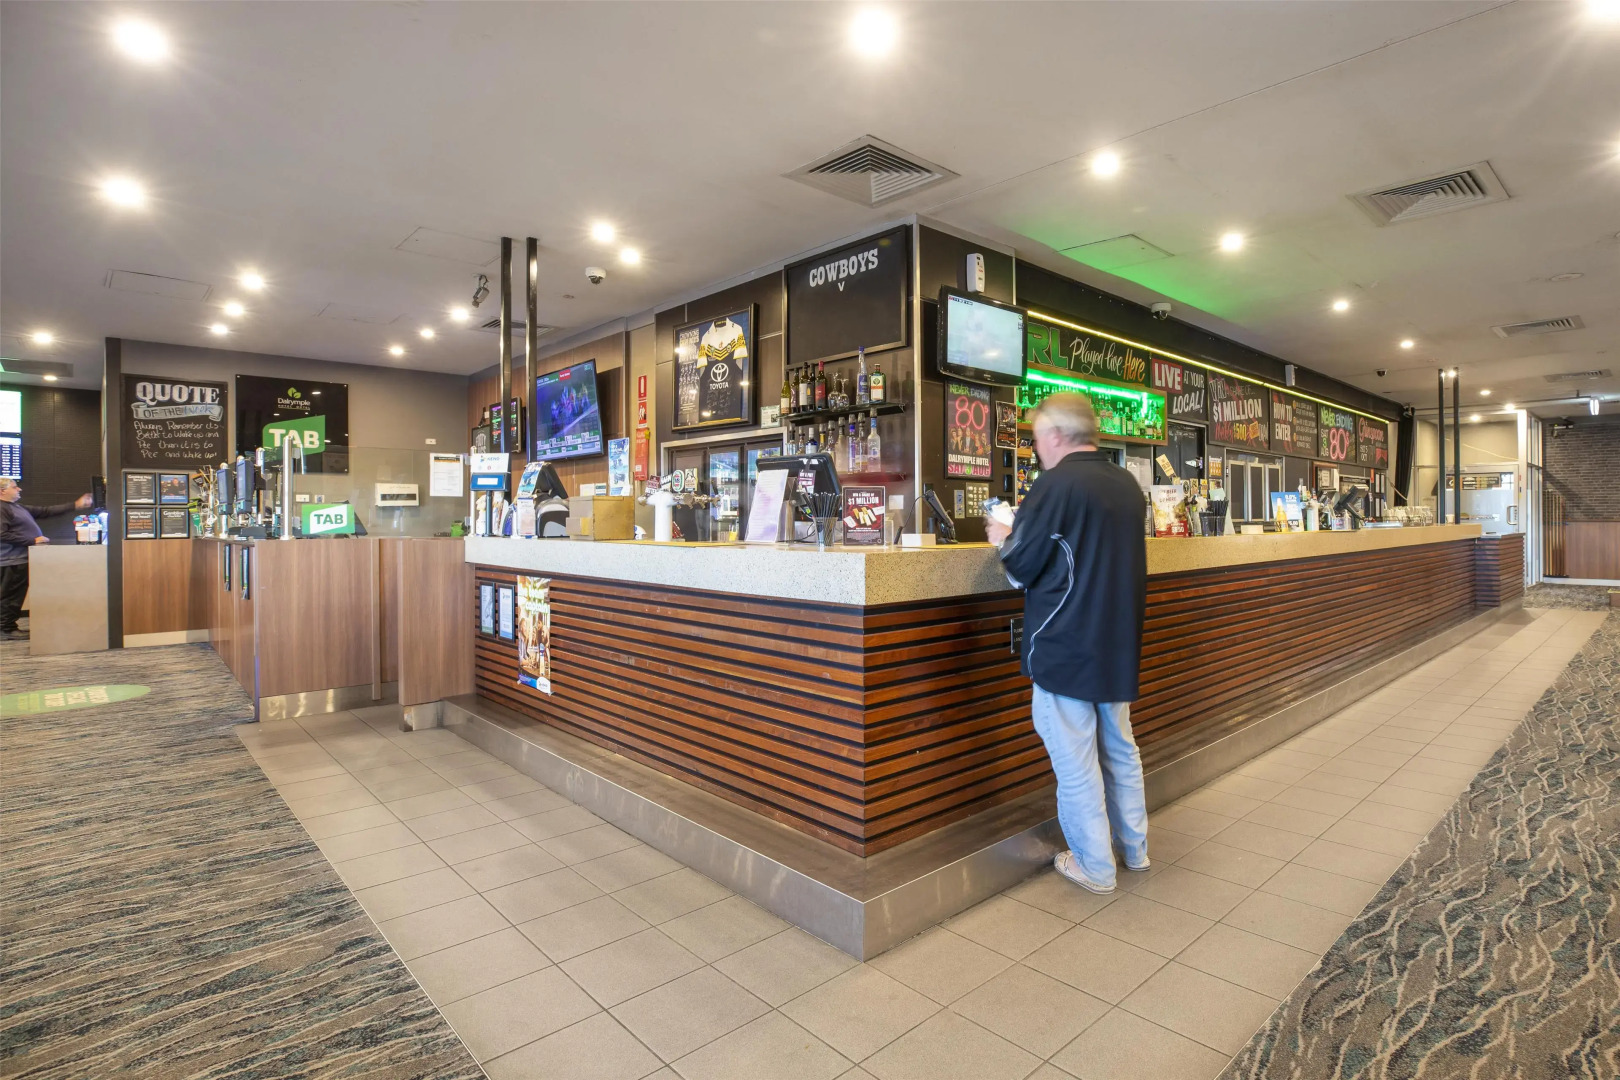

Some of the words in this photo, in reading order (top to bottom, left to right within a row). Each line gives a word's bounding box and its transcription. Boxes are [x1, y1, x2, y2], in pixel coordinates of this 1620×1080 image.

[809, 248, 878, 288] COWBOYS
[1027, 322, 1069, 369] RL
[1069, 337, 1105, 376] Played
[1123, 348, 1145, 382] Here
[1154, 363, 1182, 390] LIVE
[1184, 370, 1190, 384] AT
[1190, 372, 1204, 388] YOUR
[136, 382, 219, 406] QUOTE
[710, 382, 729, 390] TOYOTA
[949, 383, 970, 396] NEVER
[278, 398, 311, 407] Dalrymple
[1172, 390, 1204, 414] LOCAL!
[1213, 402, 1222, 422] $1
[1222, 398, 1262, 422] MILLION
[144, 410, 158, 418] OF
[161, 408, 182, 416] THE
[268, 428, 320, 448] TAB
[948, 454, 976, 465] DALRYMPLE
[976, 458, 990, 466] HOTEL
[948, 464, 964, 475] SAT
[972, 466, 990, 476] AUG
[314, 514, 344, 525] TAB
